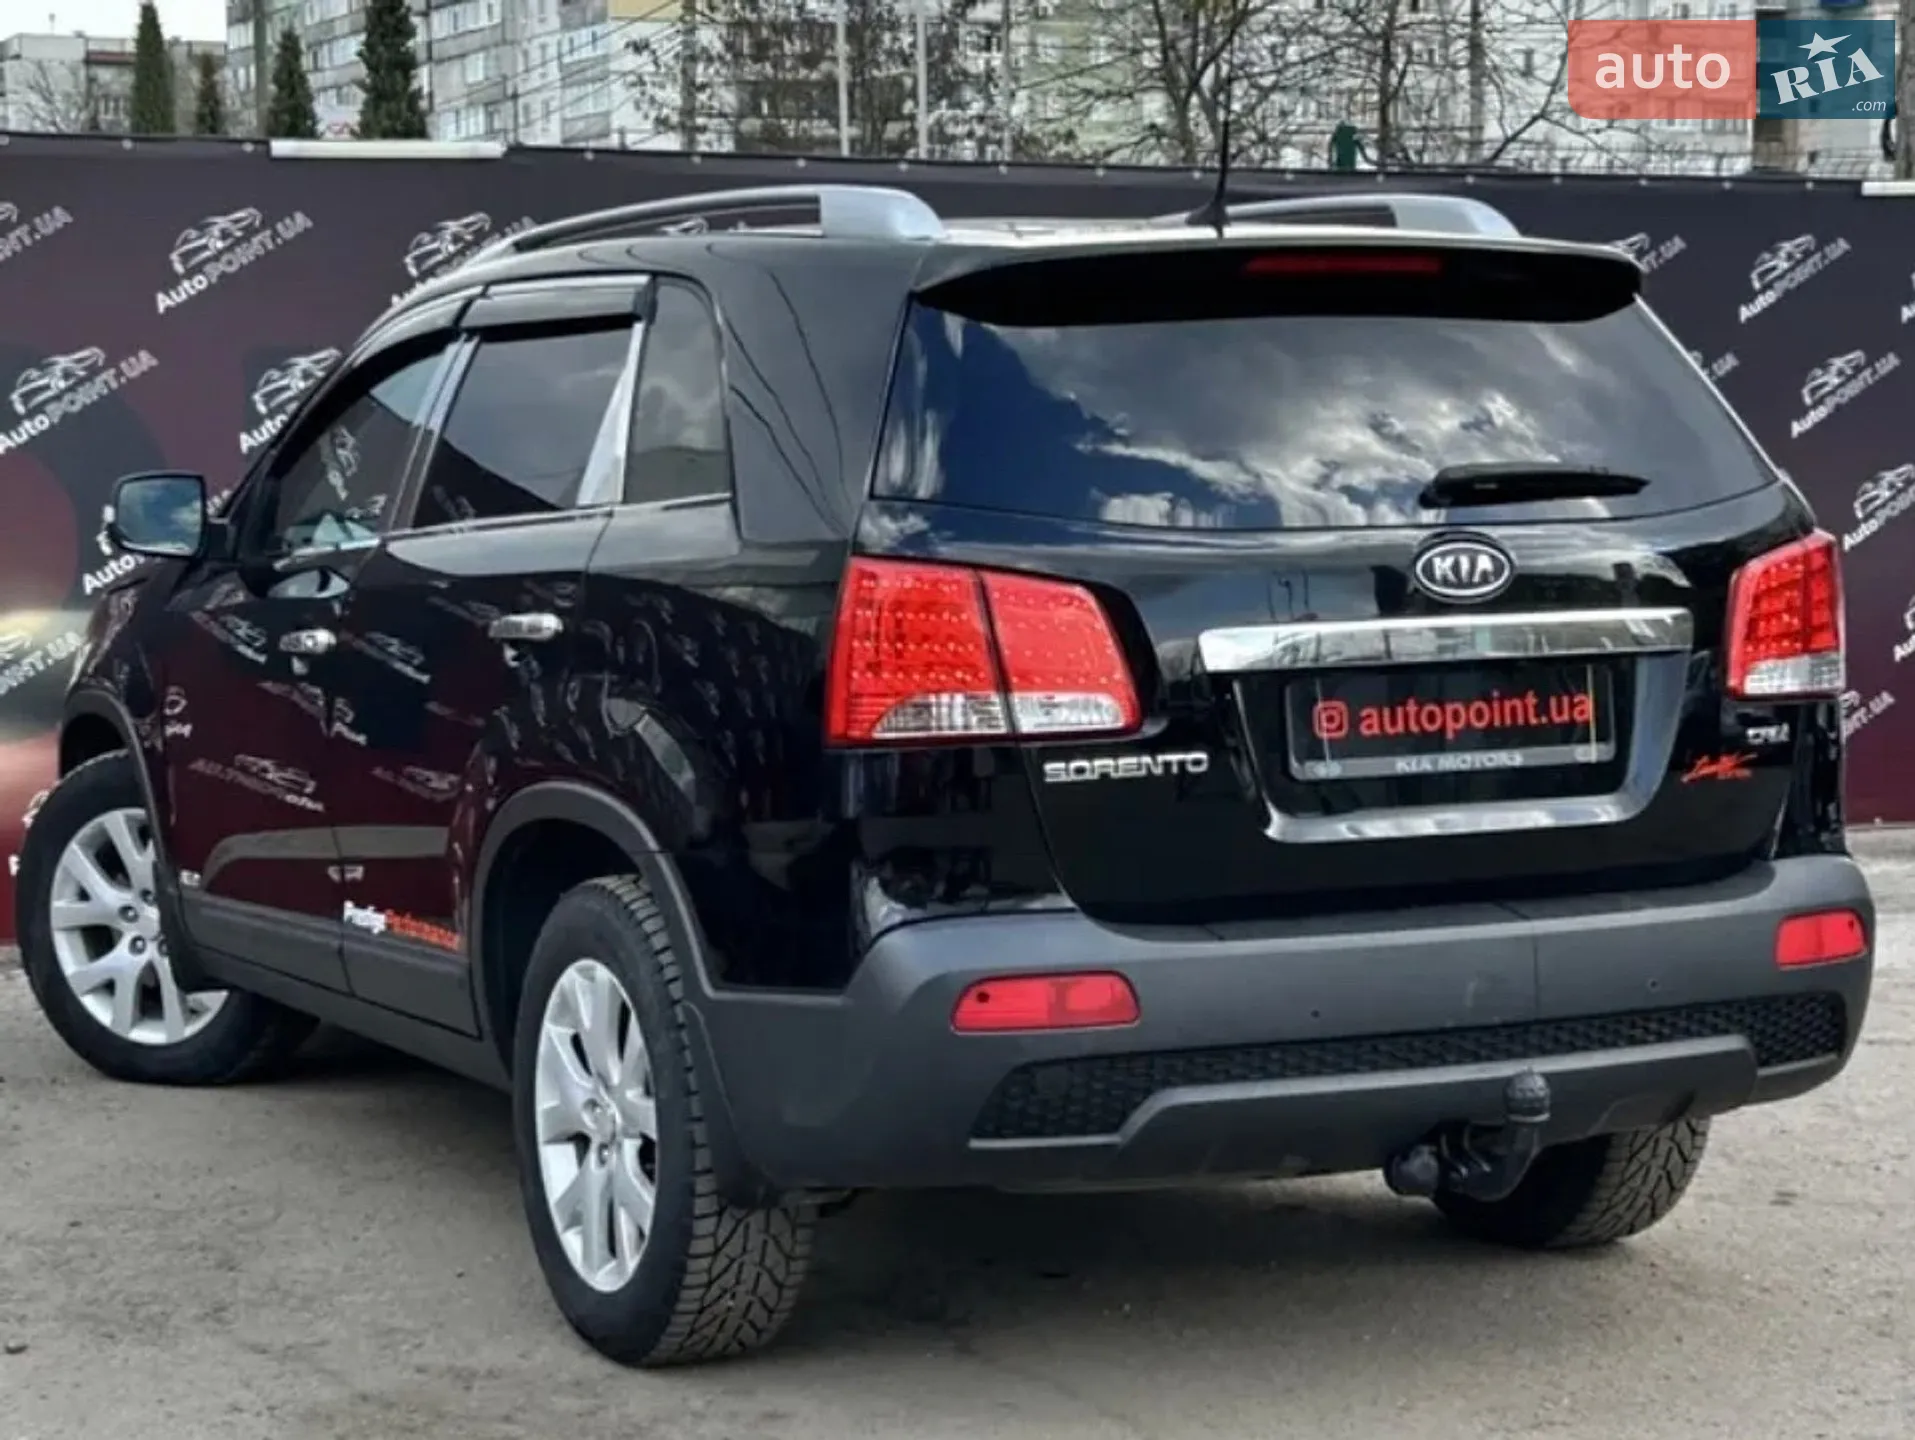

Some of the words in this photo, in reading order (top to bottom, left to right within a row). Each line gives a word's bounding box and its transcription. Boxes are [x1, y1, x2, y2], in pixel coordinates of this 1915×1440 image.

[1432, 554, 1495, 583] KIA
[1359, 690, 1591, 740] autopoint.ua
[1043, 751, 1209, 783] SORENTO
